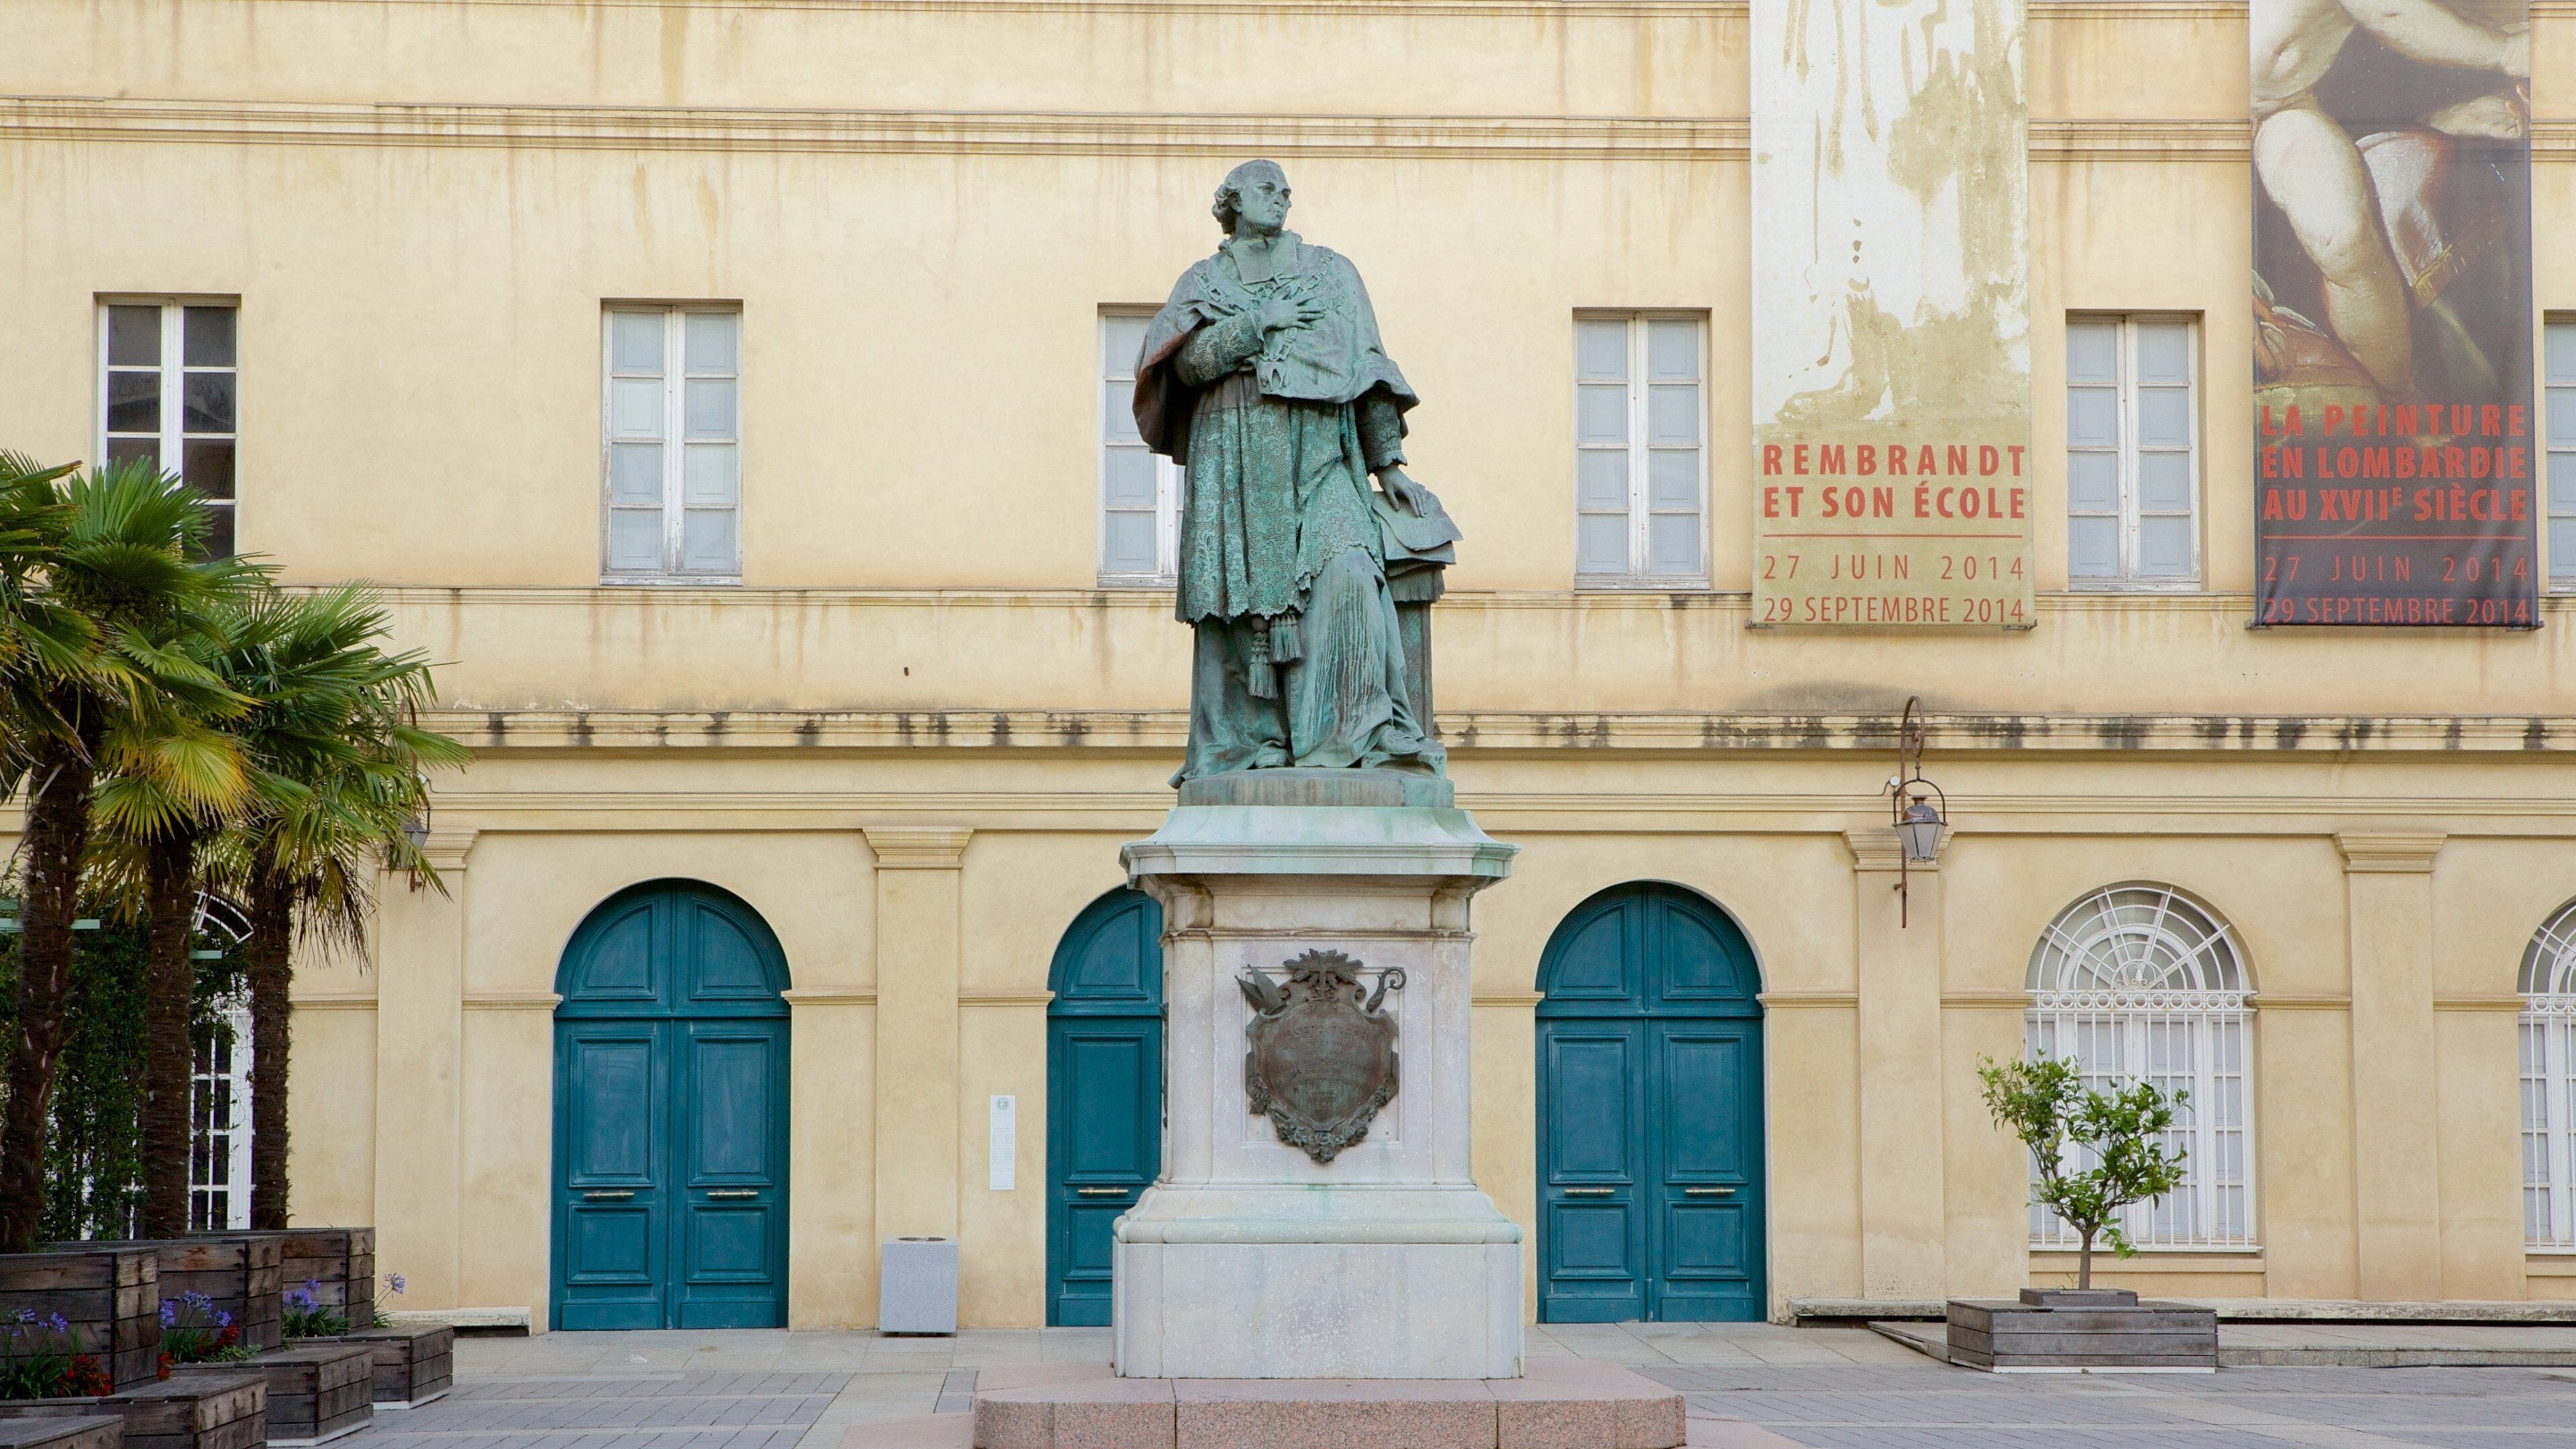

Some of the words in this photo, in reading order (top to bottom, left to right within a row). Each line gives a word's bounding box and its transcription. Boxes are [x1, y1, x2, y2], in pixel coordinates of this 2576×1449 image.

[2262, 405, 2303, 436] LA
[2324, 404, 2524, 436] PEINTURE
[1764, 444, 2024, 476] REMBRANDT
[2263, 447, 2302, 478] EN
[2318, 446, 2525, 478] LOMBARDIE
[1764, 486, 1803, 517] ET
[1823, 486, 1893, 517] SON
[1915, 481, 2025, 519] ÉCOLE
[2263, 488, 2306, 521] AU
[2414, 482, 2526, 521] SIÈCLE
[1764, 554, 1801, 581] 27
[1831, 554, 1909, 580] JUIN
[1941, 555, 2023, 580] 2014
[2264, 555, 2300, 582] 27
[2331, 555, 2410, 582] JUIN
[2443, 555, 2528, 583] 2014
[1763, 597, 1793, 623] 29
[1805, 596, 1949, 623] SEPTEMBRE
[1964, 598, 2024, 623] 2014
[2265, 598, 2295, 625] 29
[2306, 596, 2453, 625] SEPTEMBRE
[2466, 598, 2528, 625] 2014
